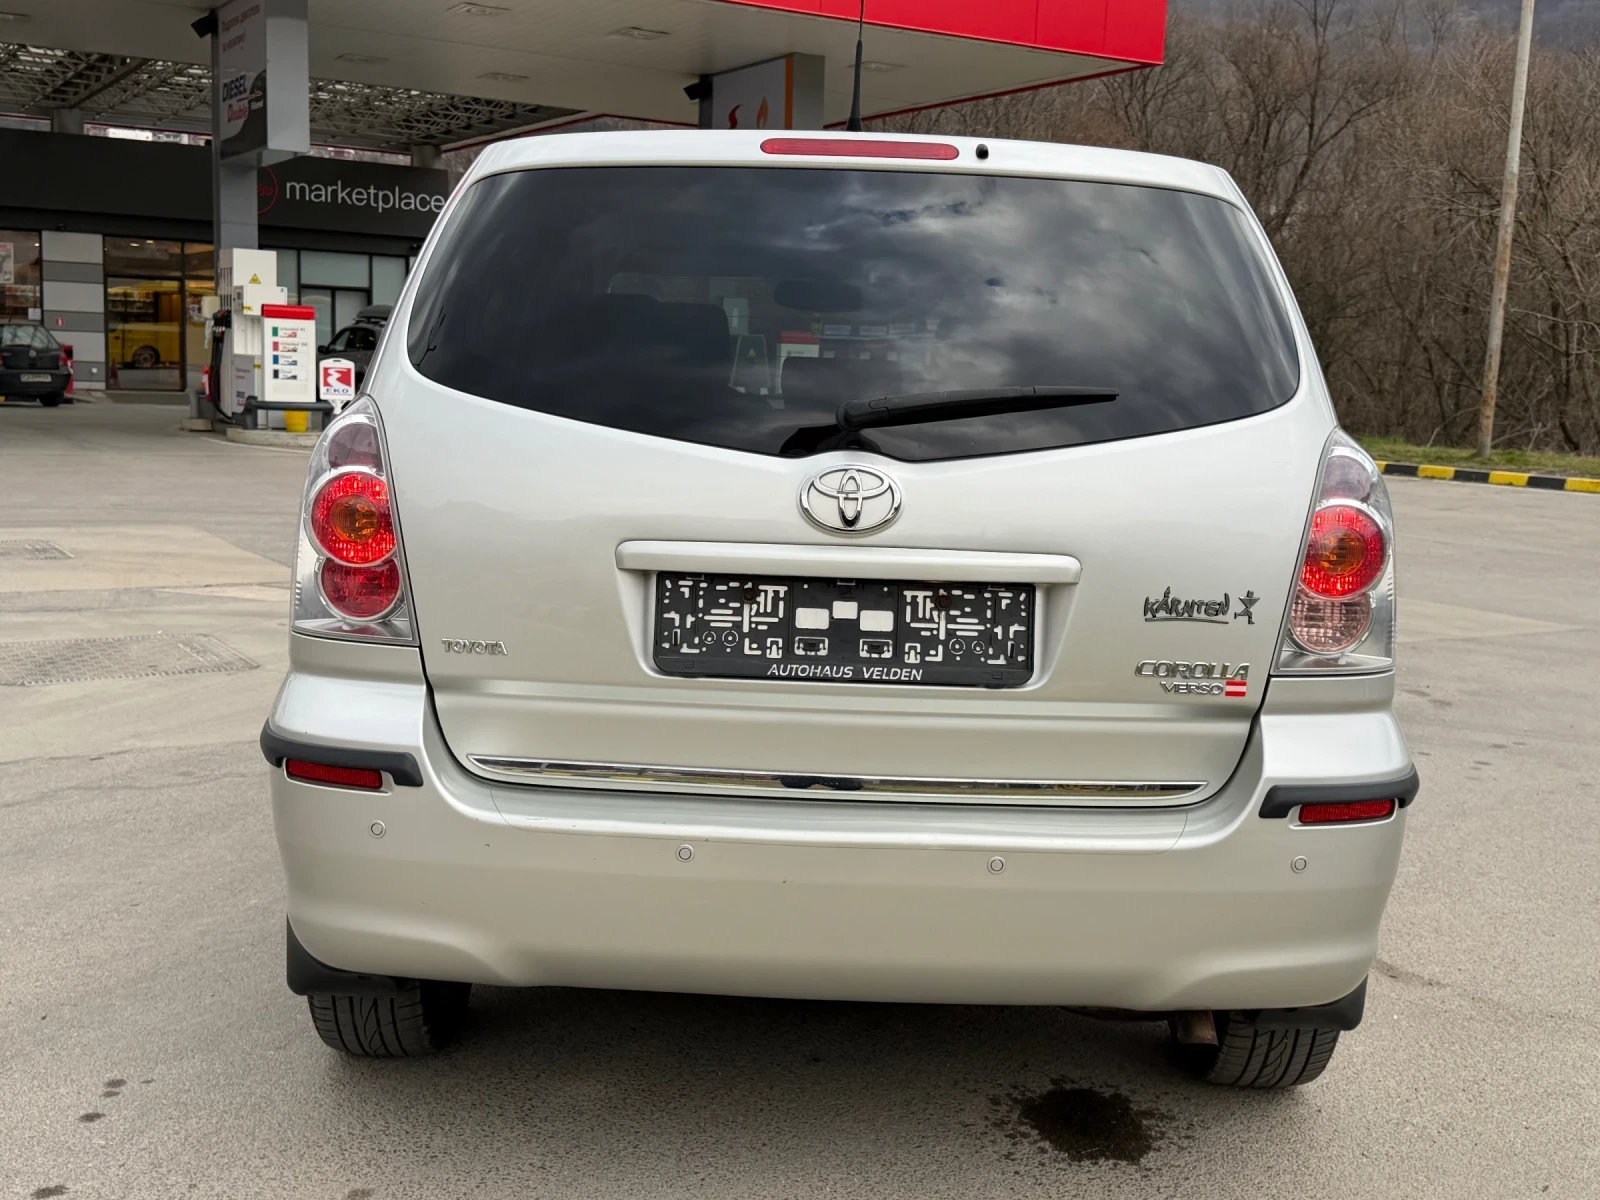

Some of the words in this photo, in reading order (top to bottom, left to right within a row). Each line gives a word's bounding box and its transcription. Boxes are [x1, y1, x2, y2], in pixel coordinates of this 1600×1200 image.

[223, 74, 247, 102] DIESEL
[286, 180, 446, 213] marketplace
[441, 638, 508, 655] TOYOTA
[766, 663, 854, 678] AUTOHAUS
[862, 666, 923, 681] VELDEN
[1135, 659, 1251, 680] COROLLA
[1160, 681, 1224, 695] VERSO
